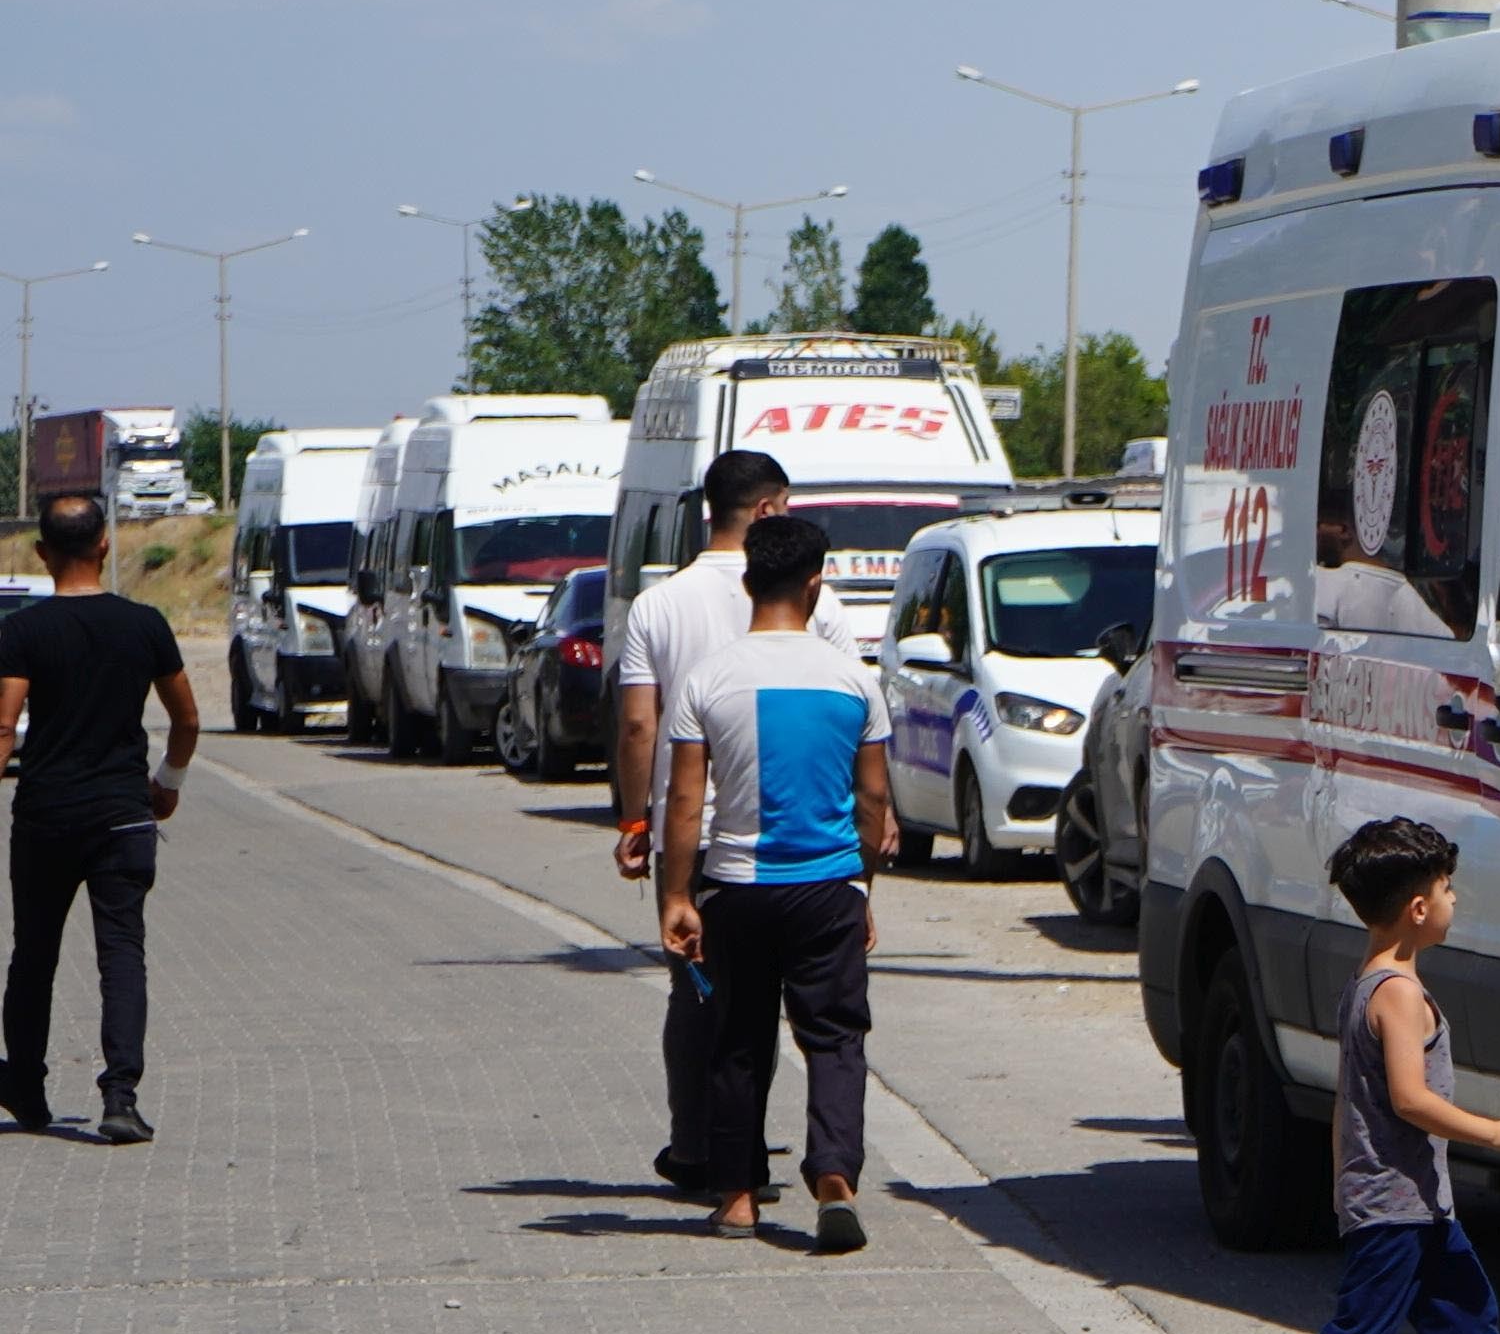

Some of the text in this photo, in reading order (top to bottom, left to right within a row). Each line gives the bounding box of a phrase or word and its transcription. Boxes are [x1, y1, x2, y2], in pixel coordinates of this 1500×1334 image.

[770, 361, 900, 377] MEMOCAN
[742, 403, 949, 440] ATEŞ
[1223, 485, 1269, 603] 112
